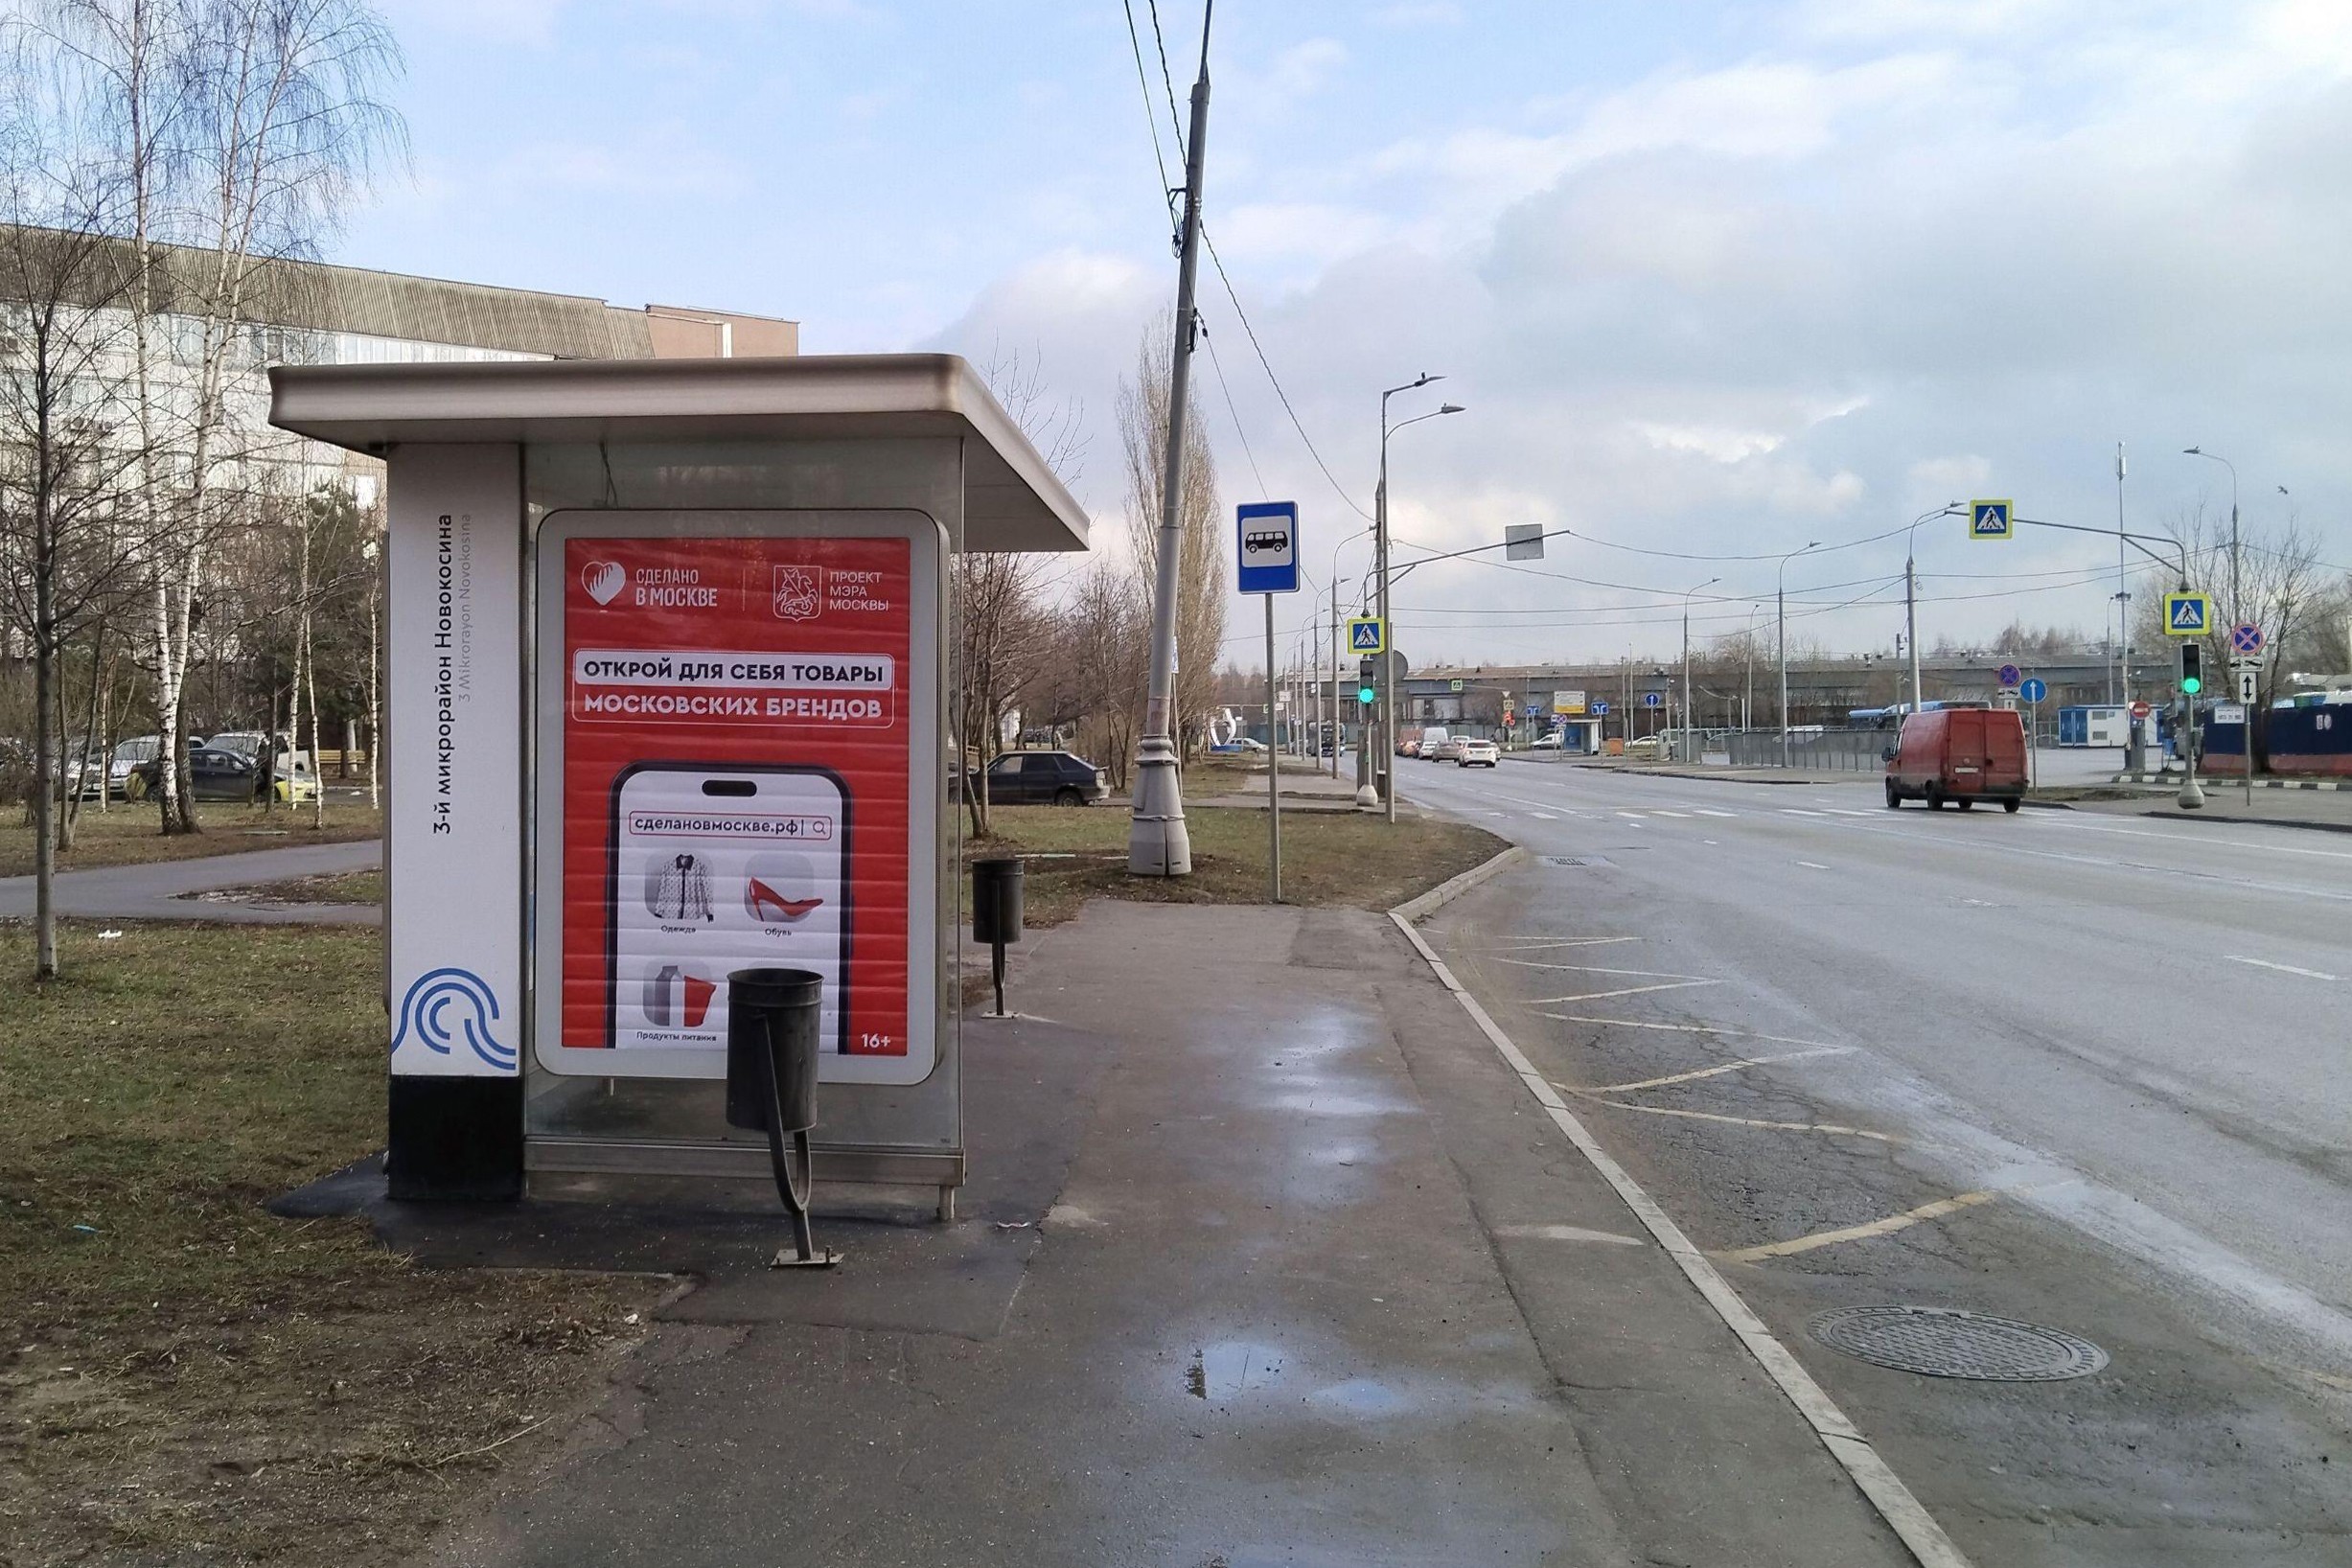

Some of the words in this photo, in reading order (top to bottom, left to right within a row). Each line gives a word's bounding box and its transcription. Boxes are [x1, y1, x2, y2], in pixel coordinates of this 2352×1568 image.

[458, 513, 471, 599] Novokosina
[434, 514, 451, 648] Новокосина
[635, 567, 699, 585] СДЕЛАНО
[829, 571, 882, 584] ПРОЕКТ
[635, 588, 648, 606] В
[649, 587, 718, 607] МОСКВЕ
[829, 586, 867, 597] МЭРА
[829, 599, 888, 611] МОСКВЫ
[458, 604, 473, 690] Mikrorayon
[584, 657, 672, 679] ОТКРОЙ
[679, 663, 723, 681] ДЛЯ
[730, 664, 785, 680] СЕБЯ
[792, 665, 883, 681] ТОВАРЫ
[458, 693, 471, 702] 3
[585, 694, 757, 716] МОСКОВСКИХ
[767, 698, 882, 720] БРЕНДОВ
[434, 656, 455, 795] микрорайон
[433, 802, 451, 835] 3-й
[634, 818, 798, 835] сделановмоскве.рф
[660, 925, 696, 934] Одежда
[765, 928, 792, 937] Обувь
[636, 1031, 680, 1042] Продукты
[861, 1033, 891, 1048] 16+
